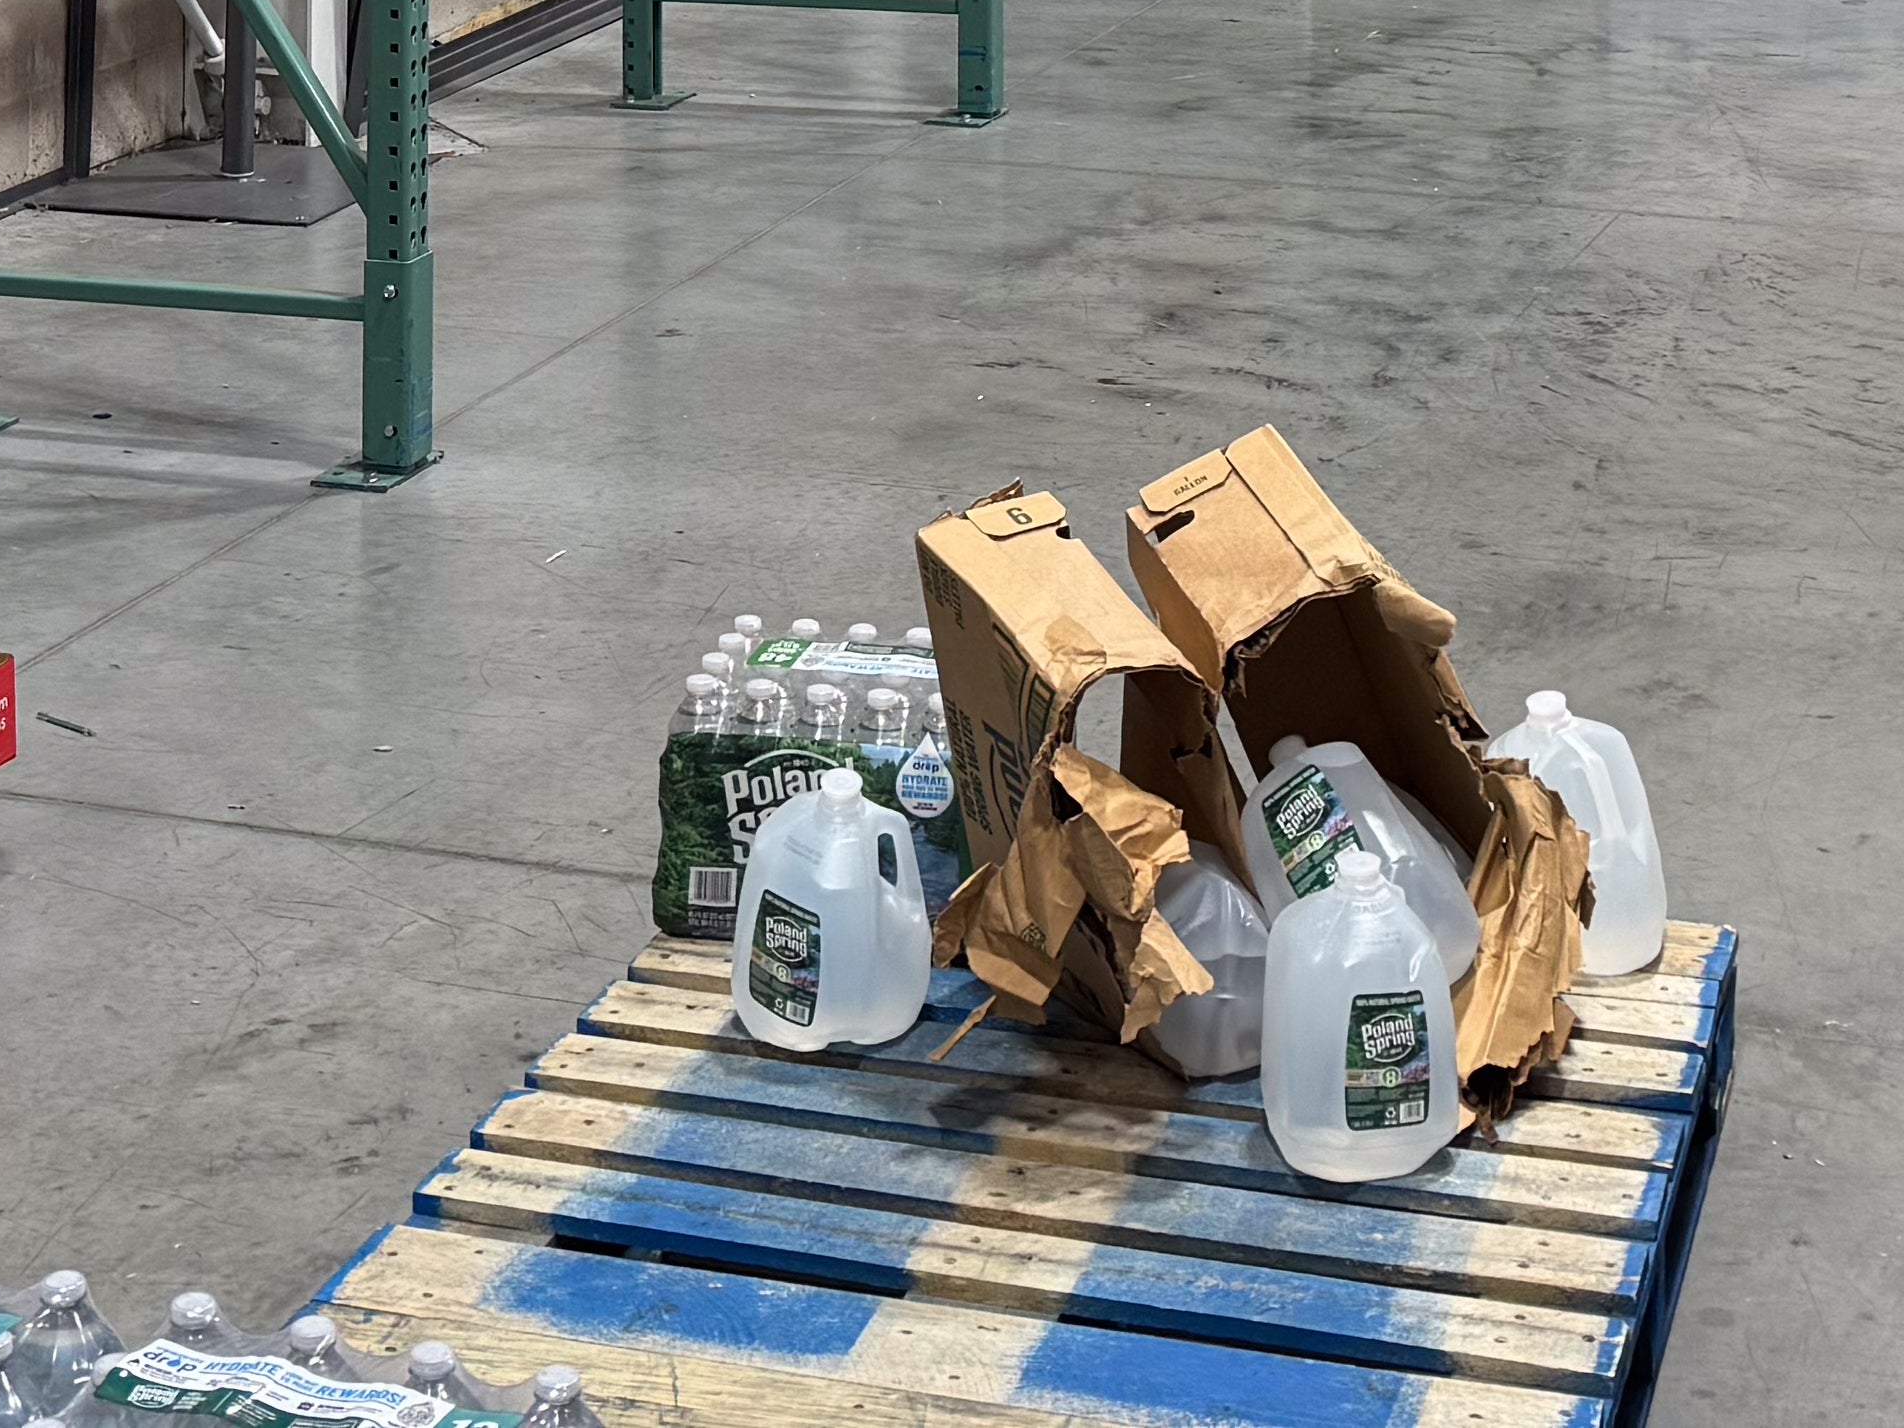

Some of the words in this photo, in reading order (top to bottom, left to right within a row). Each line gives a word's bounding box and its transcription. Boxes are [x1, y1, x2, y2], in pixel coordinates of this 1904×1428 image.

[901, 774, 948, 786] HYDRATE
[1276, 784, 1319, 830] Poland
[1283, 795, 1325, 840] Spring
[765, 917, 807, 942] Poland
[765, 932, 807, 958] Spring
[1361, 1013, 1414, 1042] Poland
[1364, 1030, 1416, 1059] Spring
[1386, 1070, 1396, 1087] 8
[143, 1350, 197, 1372] drop
[204, 1360, 283, 1375] HYDRATE
[315, 1384, 407, 1406] REWARDS!
